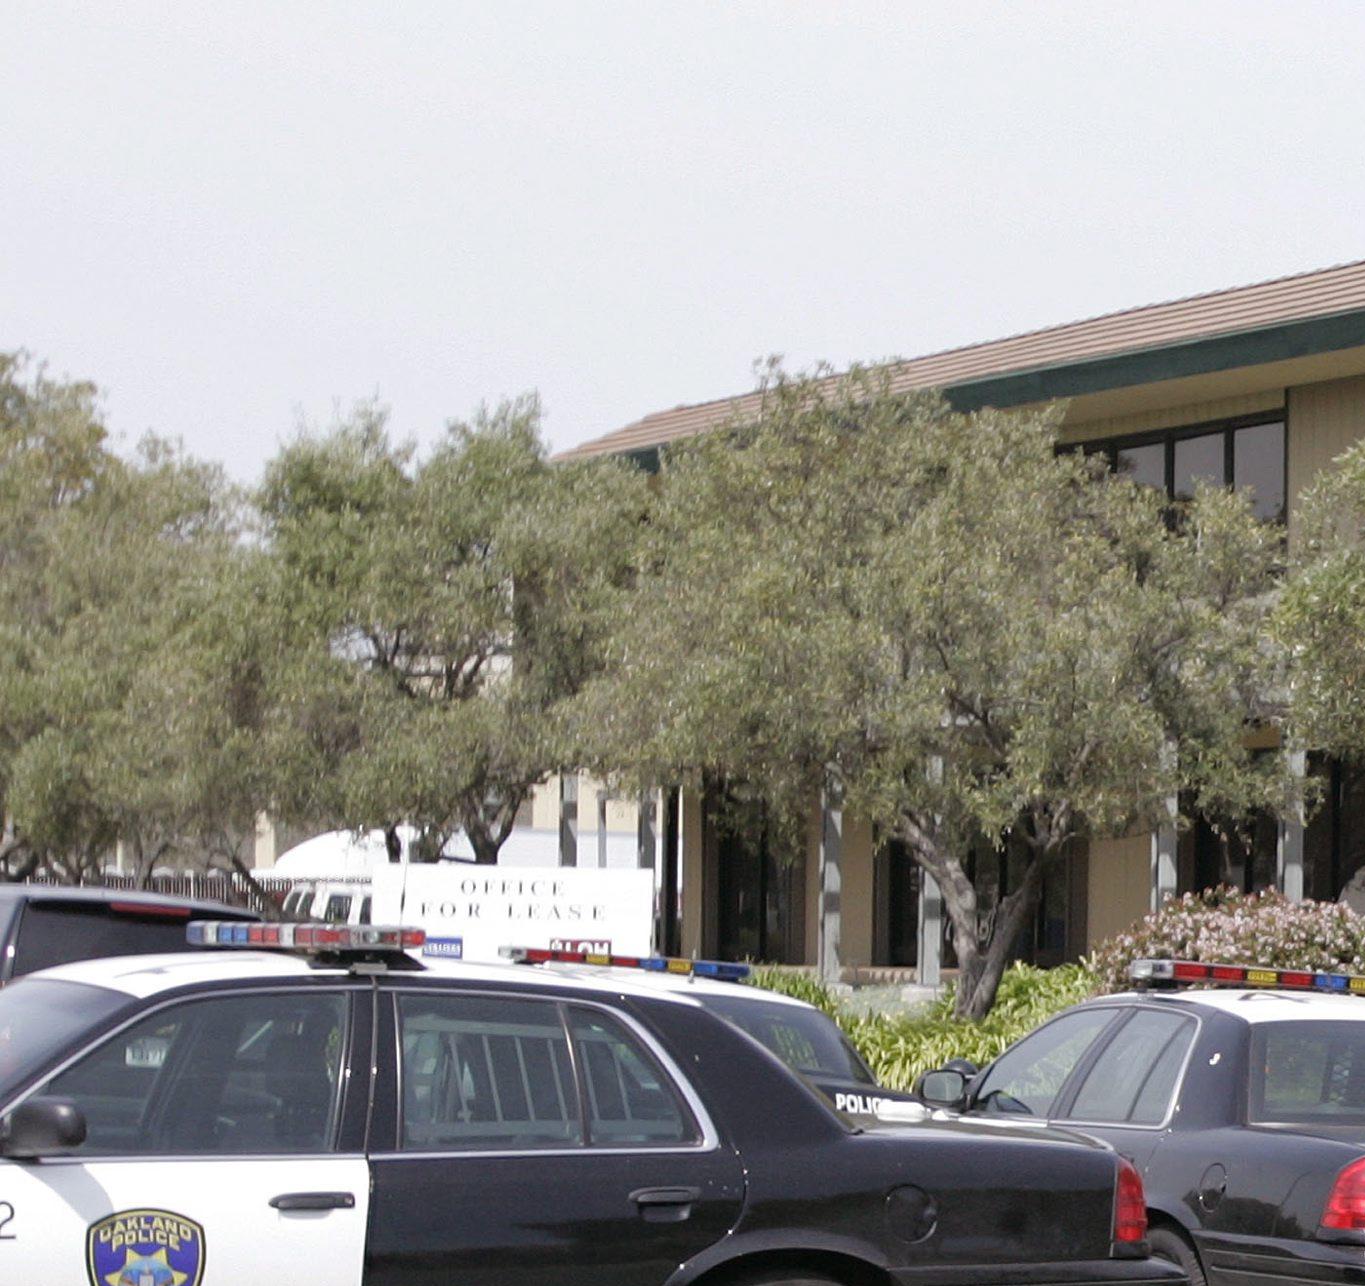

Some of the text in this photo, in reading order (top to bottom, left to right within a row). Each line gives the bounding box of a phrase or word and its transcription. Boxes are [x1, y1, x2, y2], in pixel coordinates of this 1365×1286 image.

[460, 879, 566, 896] OFFICE
[421, 902, 607, 921] FOR LEASE
[100, 1215, 191, 1243] OAKLAND
[112, 1229, 180, 1252] POLICE
